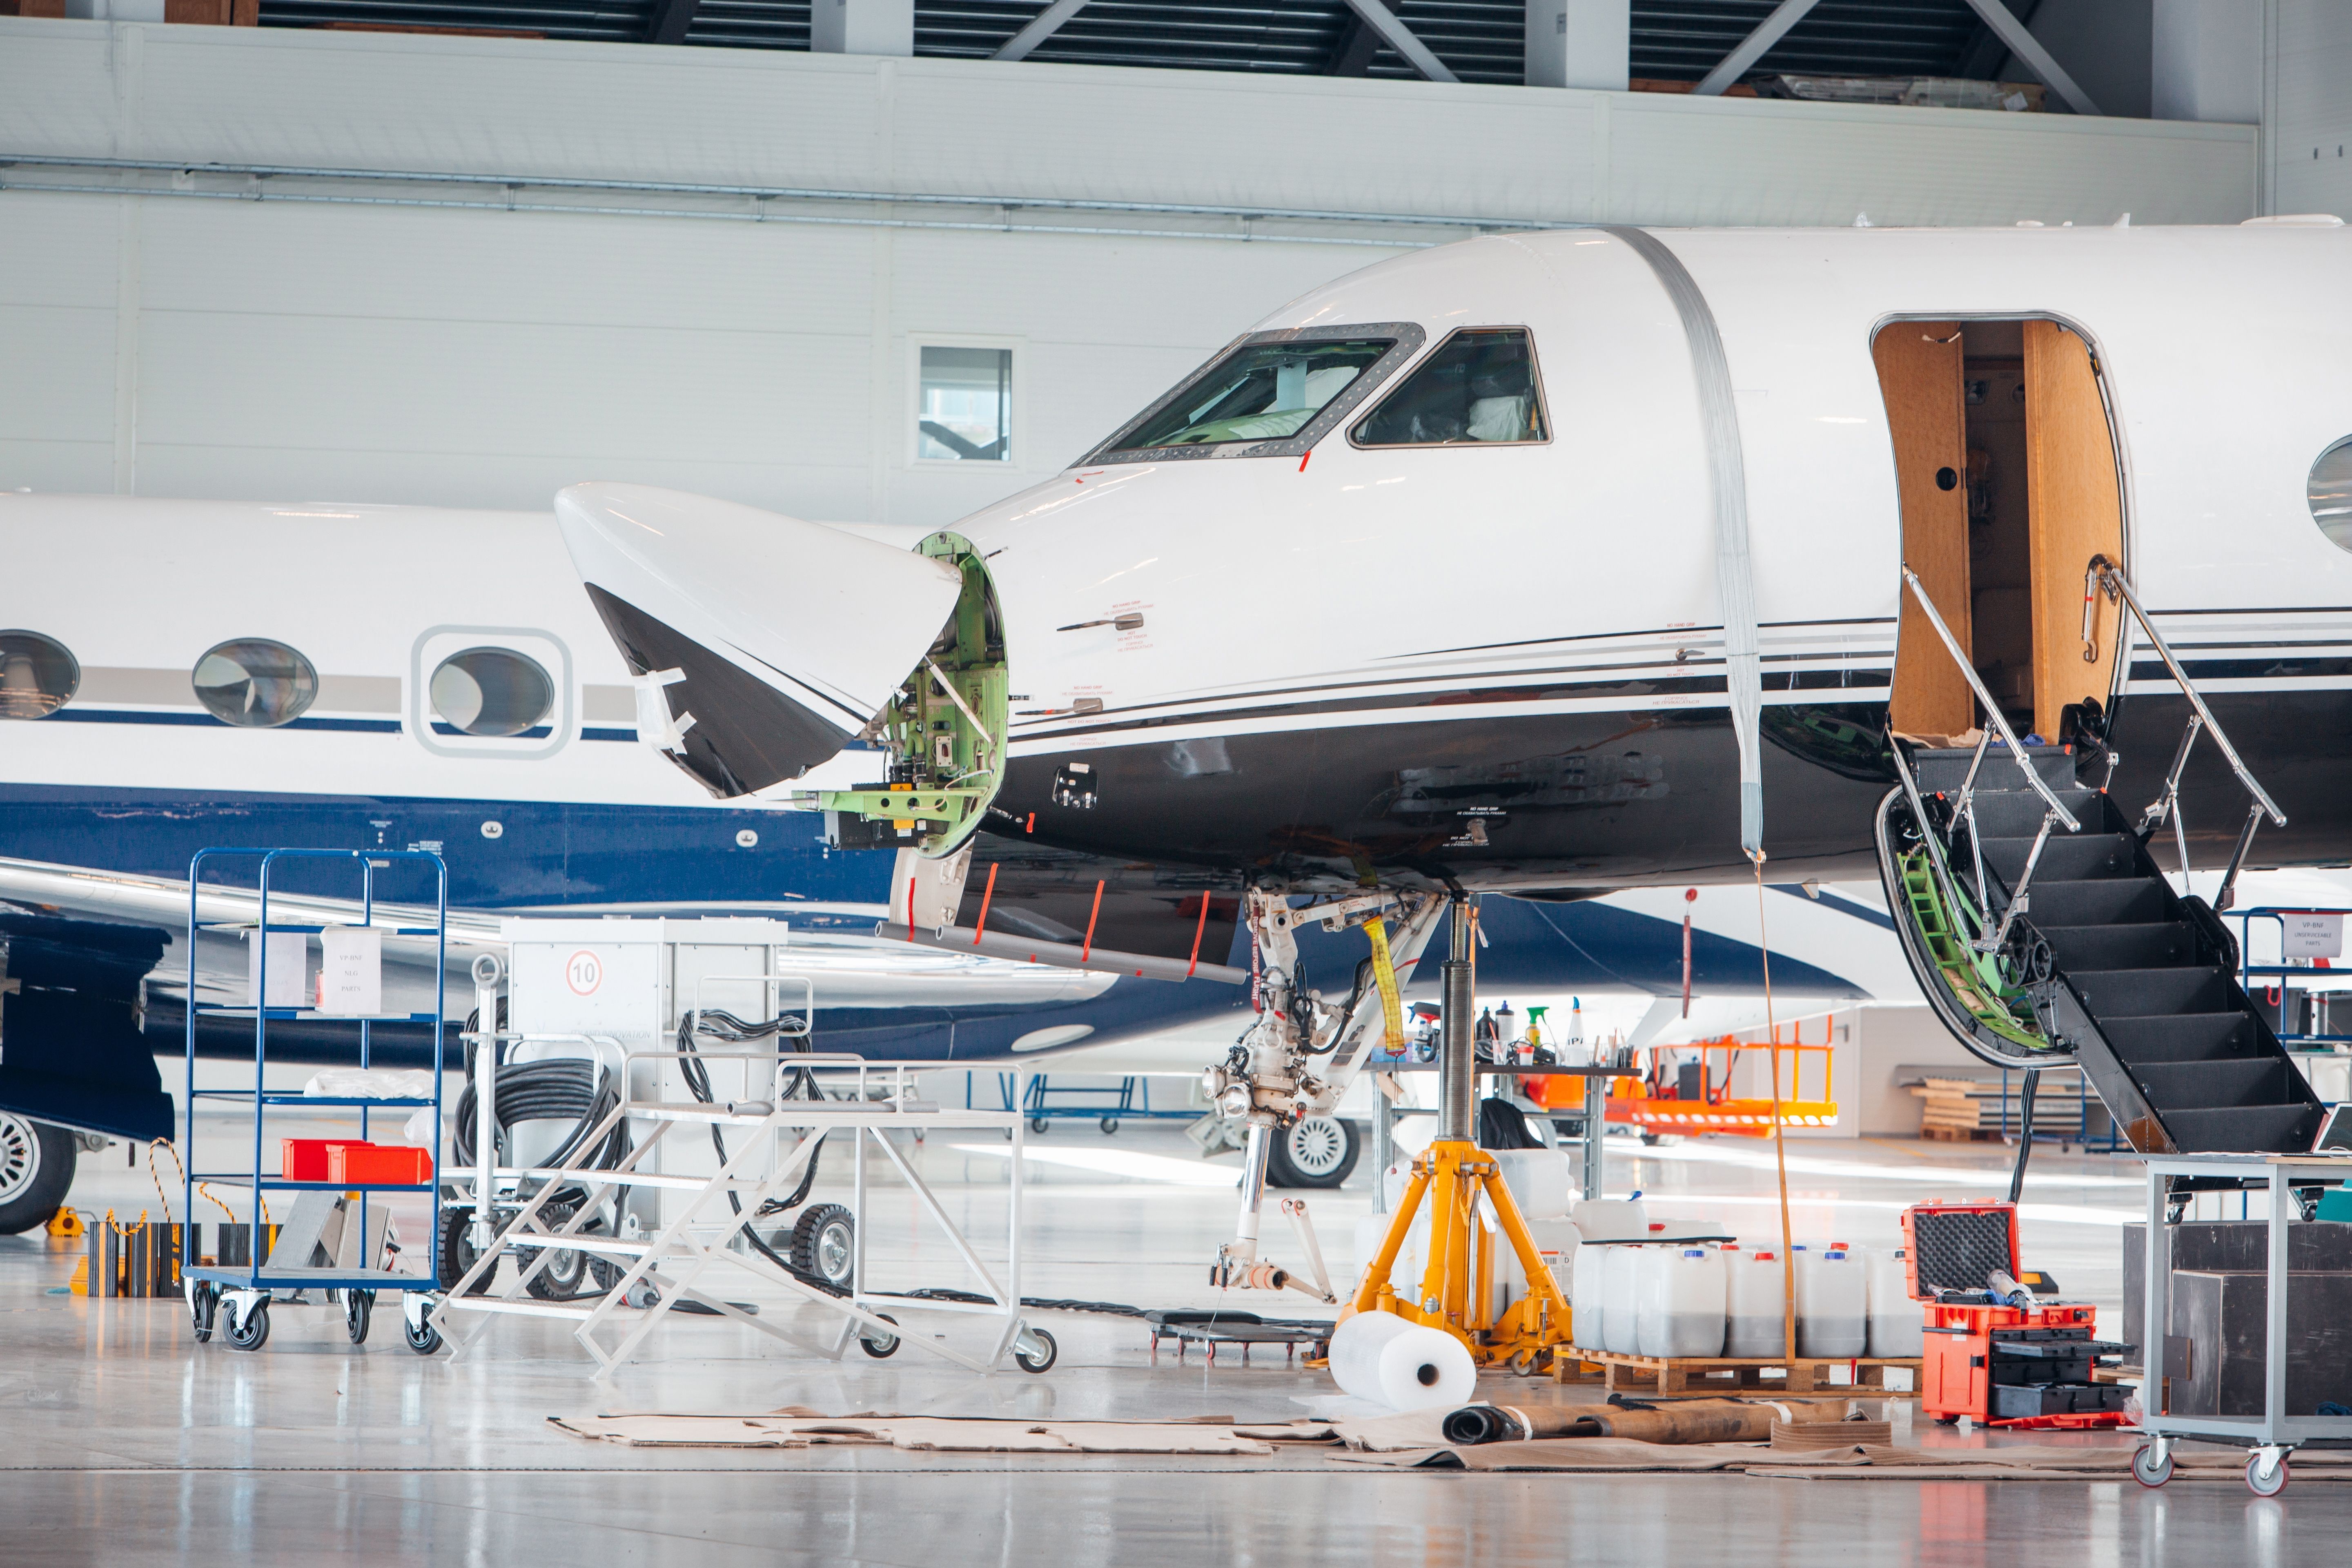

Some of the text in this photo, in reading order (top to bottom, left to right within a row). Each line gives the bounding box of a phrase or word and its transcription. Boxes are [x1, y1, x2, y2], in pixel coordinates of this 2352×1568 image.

[574, 962, 595, 983] 10
[1252, 976, 1260, 1000] FLIGHT
[602, 1030, 650, 1039] INNOVATION
